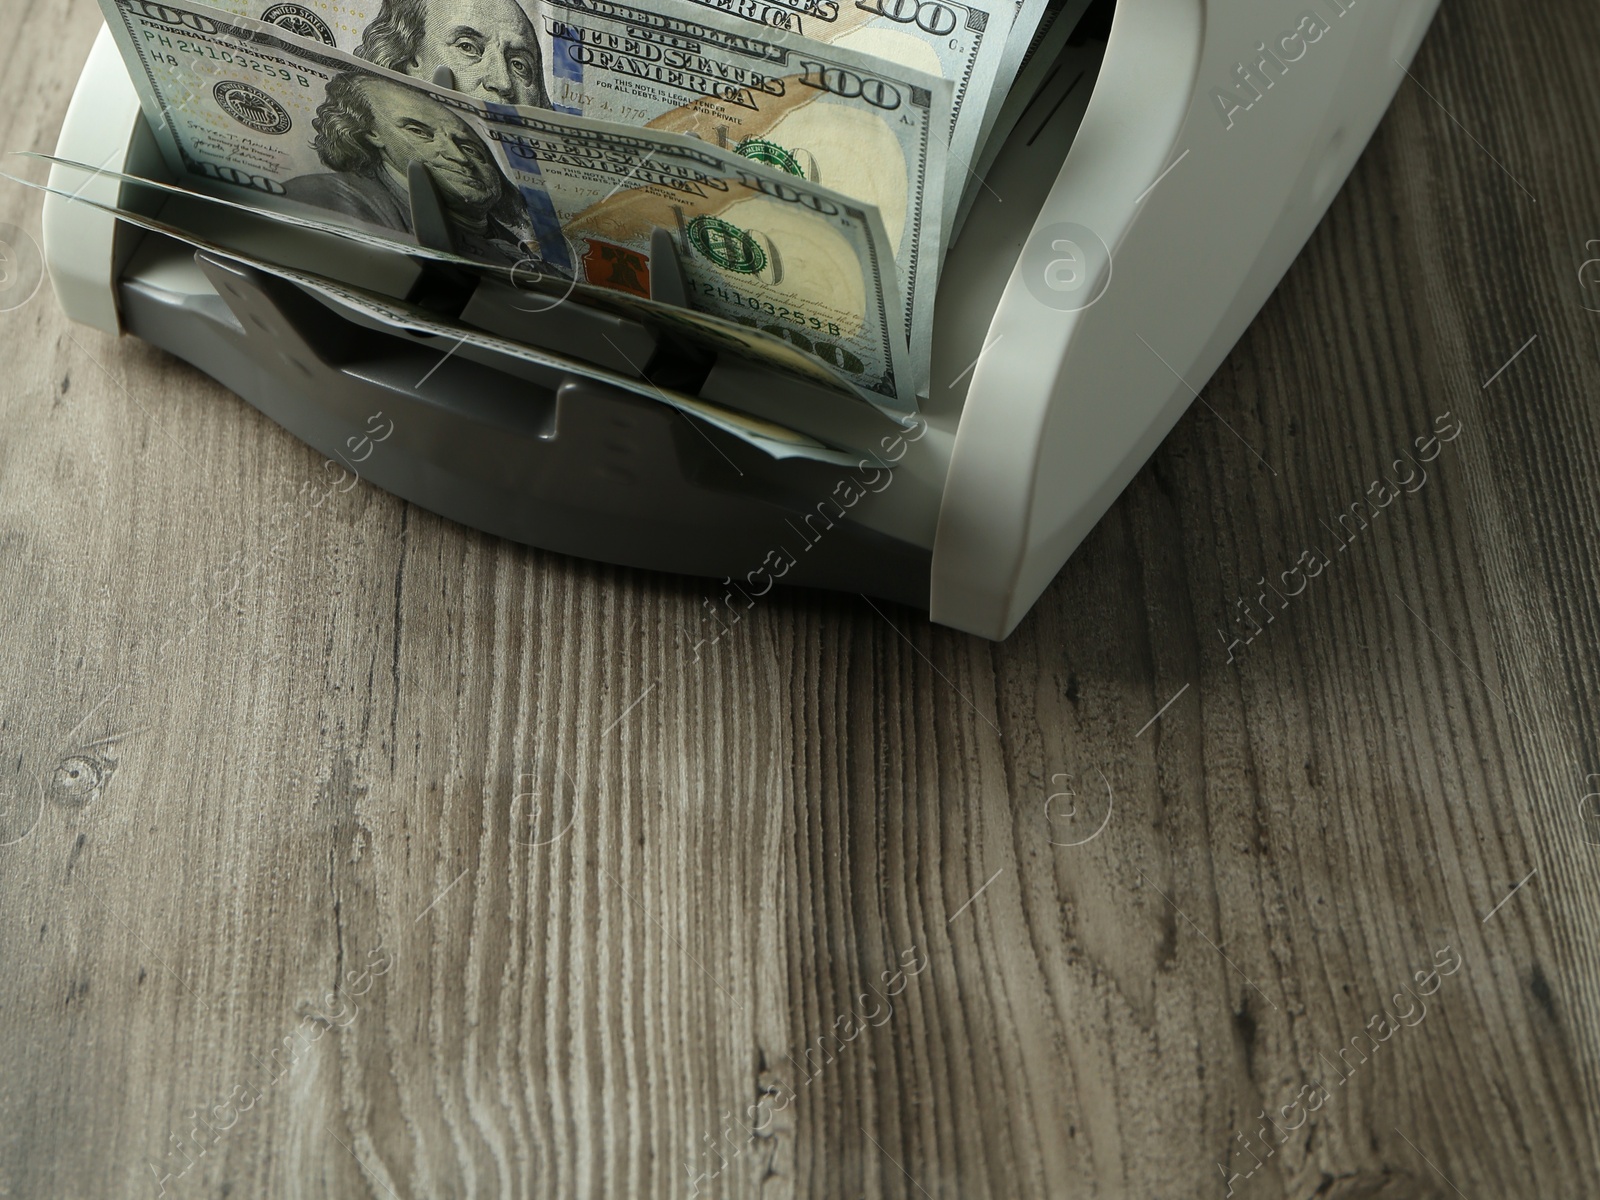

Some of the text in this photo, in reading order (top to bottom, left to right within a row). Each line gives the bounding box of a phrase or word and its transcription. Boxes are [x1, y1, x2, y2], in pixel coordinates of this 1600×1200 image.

[126, 0, 218, 35] 100
[268, 5, 325, 32] UNITED STATES
[626, 25, 701, 54] THE
[140, 19, 211, 44] FEDERAL
[286, 58, 329, 81] NOTE
[143, 30, 173, 49] PH
[177, 40, 291, 81] 24103259
[296, 74, 310, 88] B
[151, 50, 178, 67] H8
[542, 14, 786, 97] UNITED STATES
[667, 21, 783, 60] DOLLARS
[568, 44, 760, 112] OF AMERICA
[614, 78, 725, 113] THIS NOTE IS LEGAL TENDER
[798, 60, 901, 110] 100
[596, 80, 613, 90] FOR
[614, 84, 630, 94] ALL
[661, 95, 691, 109] PUBLIC
[693, 106, 710, 115] AND
[712, 110, 742, 125] PRIVATE
[196, 161, 287, 195] 100
[478, 122, 603, 159] UNITED
[604, 150, 729, 192] STATES
[554, 154, 709, 199] AMERICA
[545, 168, 562, 176] FOR
[564, 171, 580, 179] ALL
[645, 189, 662, 197] AND
[663, 192, 695, 206] PRIVATE
[562, 167, 581, 176] THIS
[583, 171, 606, 180] NOTE
[645, 185, 676, 197] TENDER
[736, 170, 839, 216] 100
[703, 284, 822, 330] 24103259
[828, 322, 840, 336] B
